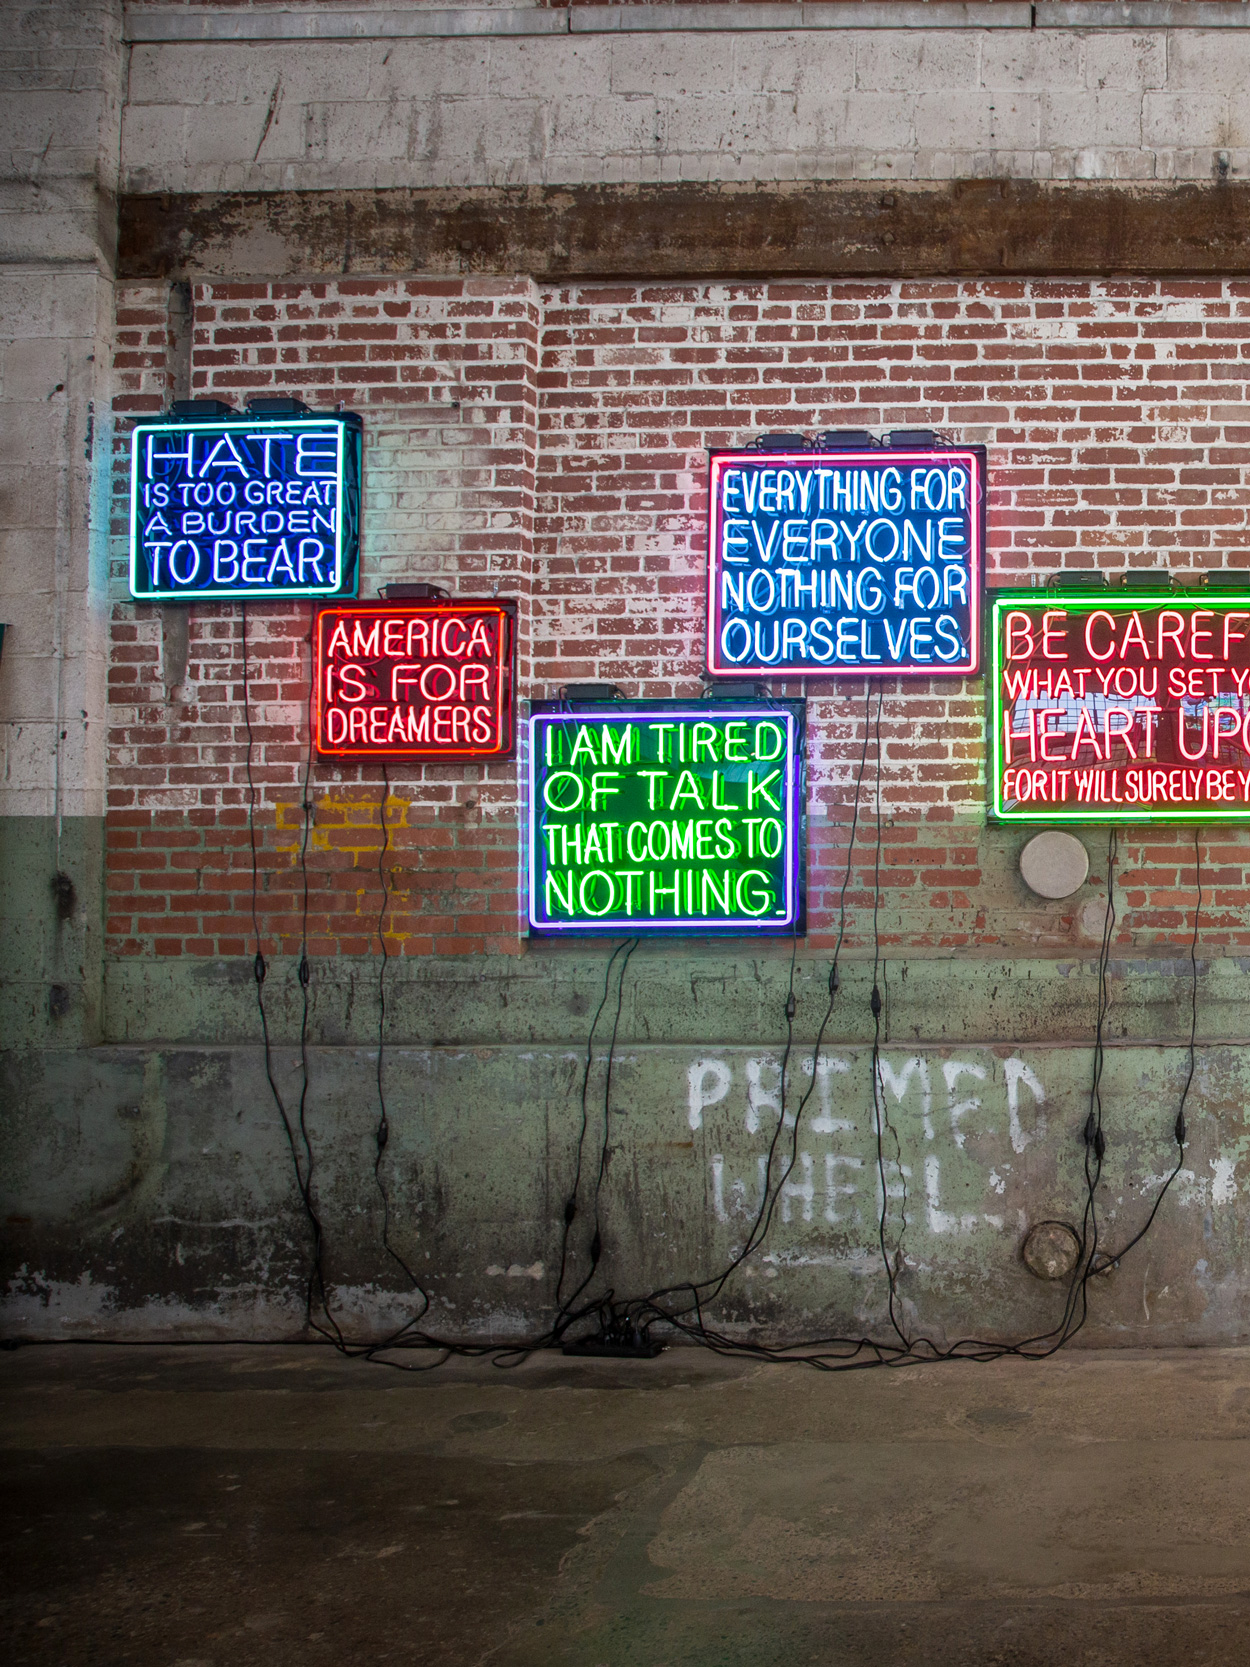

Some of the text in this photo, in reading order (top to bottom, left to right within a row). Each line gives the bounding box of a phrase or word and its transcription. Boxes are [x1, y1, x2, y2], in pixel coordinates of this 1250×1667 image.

[146, 432, 339, 479] HATE
[144, 480, 337, 507] IS TOO GREAT
[723, 467, 966, 513] EVERYTHING FOR
[144, 508, 337, 536] A BURDEN
[722, 517, 964, 562] EVERYONE
[144, 539, 200, 585] TO
[721, 564, 966, 612] NOTHING FOR
[327, 618, 491, 657] AMERICA
[721, 615, 967, 662] OURSELVES.
[1006, 610, 1068, 660] BE
[326, 663, 490, 702] IS FOR
[1003, 668, 1092, 699] WHAT
[1095, 666, 1158, 696] YOU
[1168, 667, 1225, 696] SET
[327, 705, 491, 743] DREAMERS
[545, 721, 782, 766] I AM TIRED
[1004, 705, 1162, 763] HEART
[543, 769, 781, 812] OF TALK
[1003, 768, 1048, 801] FOR
[1051, 770, 1072, 801] IT
[1074, 770, 1123, 802] WILL
[1125, 768, 1203, 802] SURELY
[1206, 770, 1235, 800] BE
[542, 817, 783, 865] THAT COMES TO
[545, 869, 786, 916] NOTHING.
